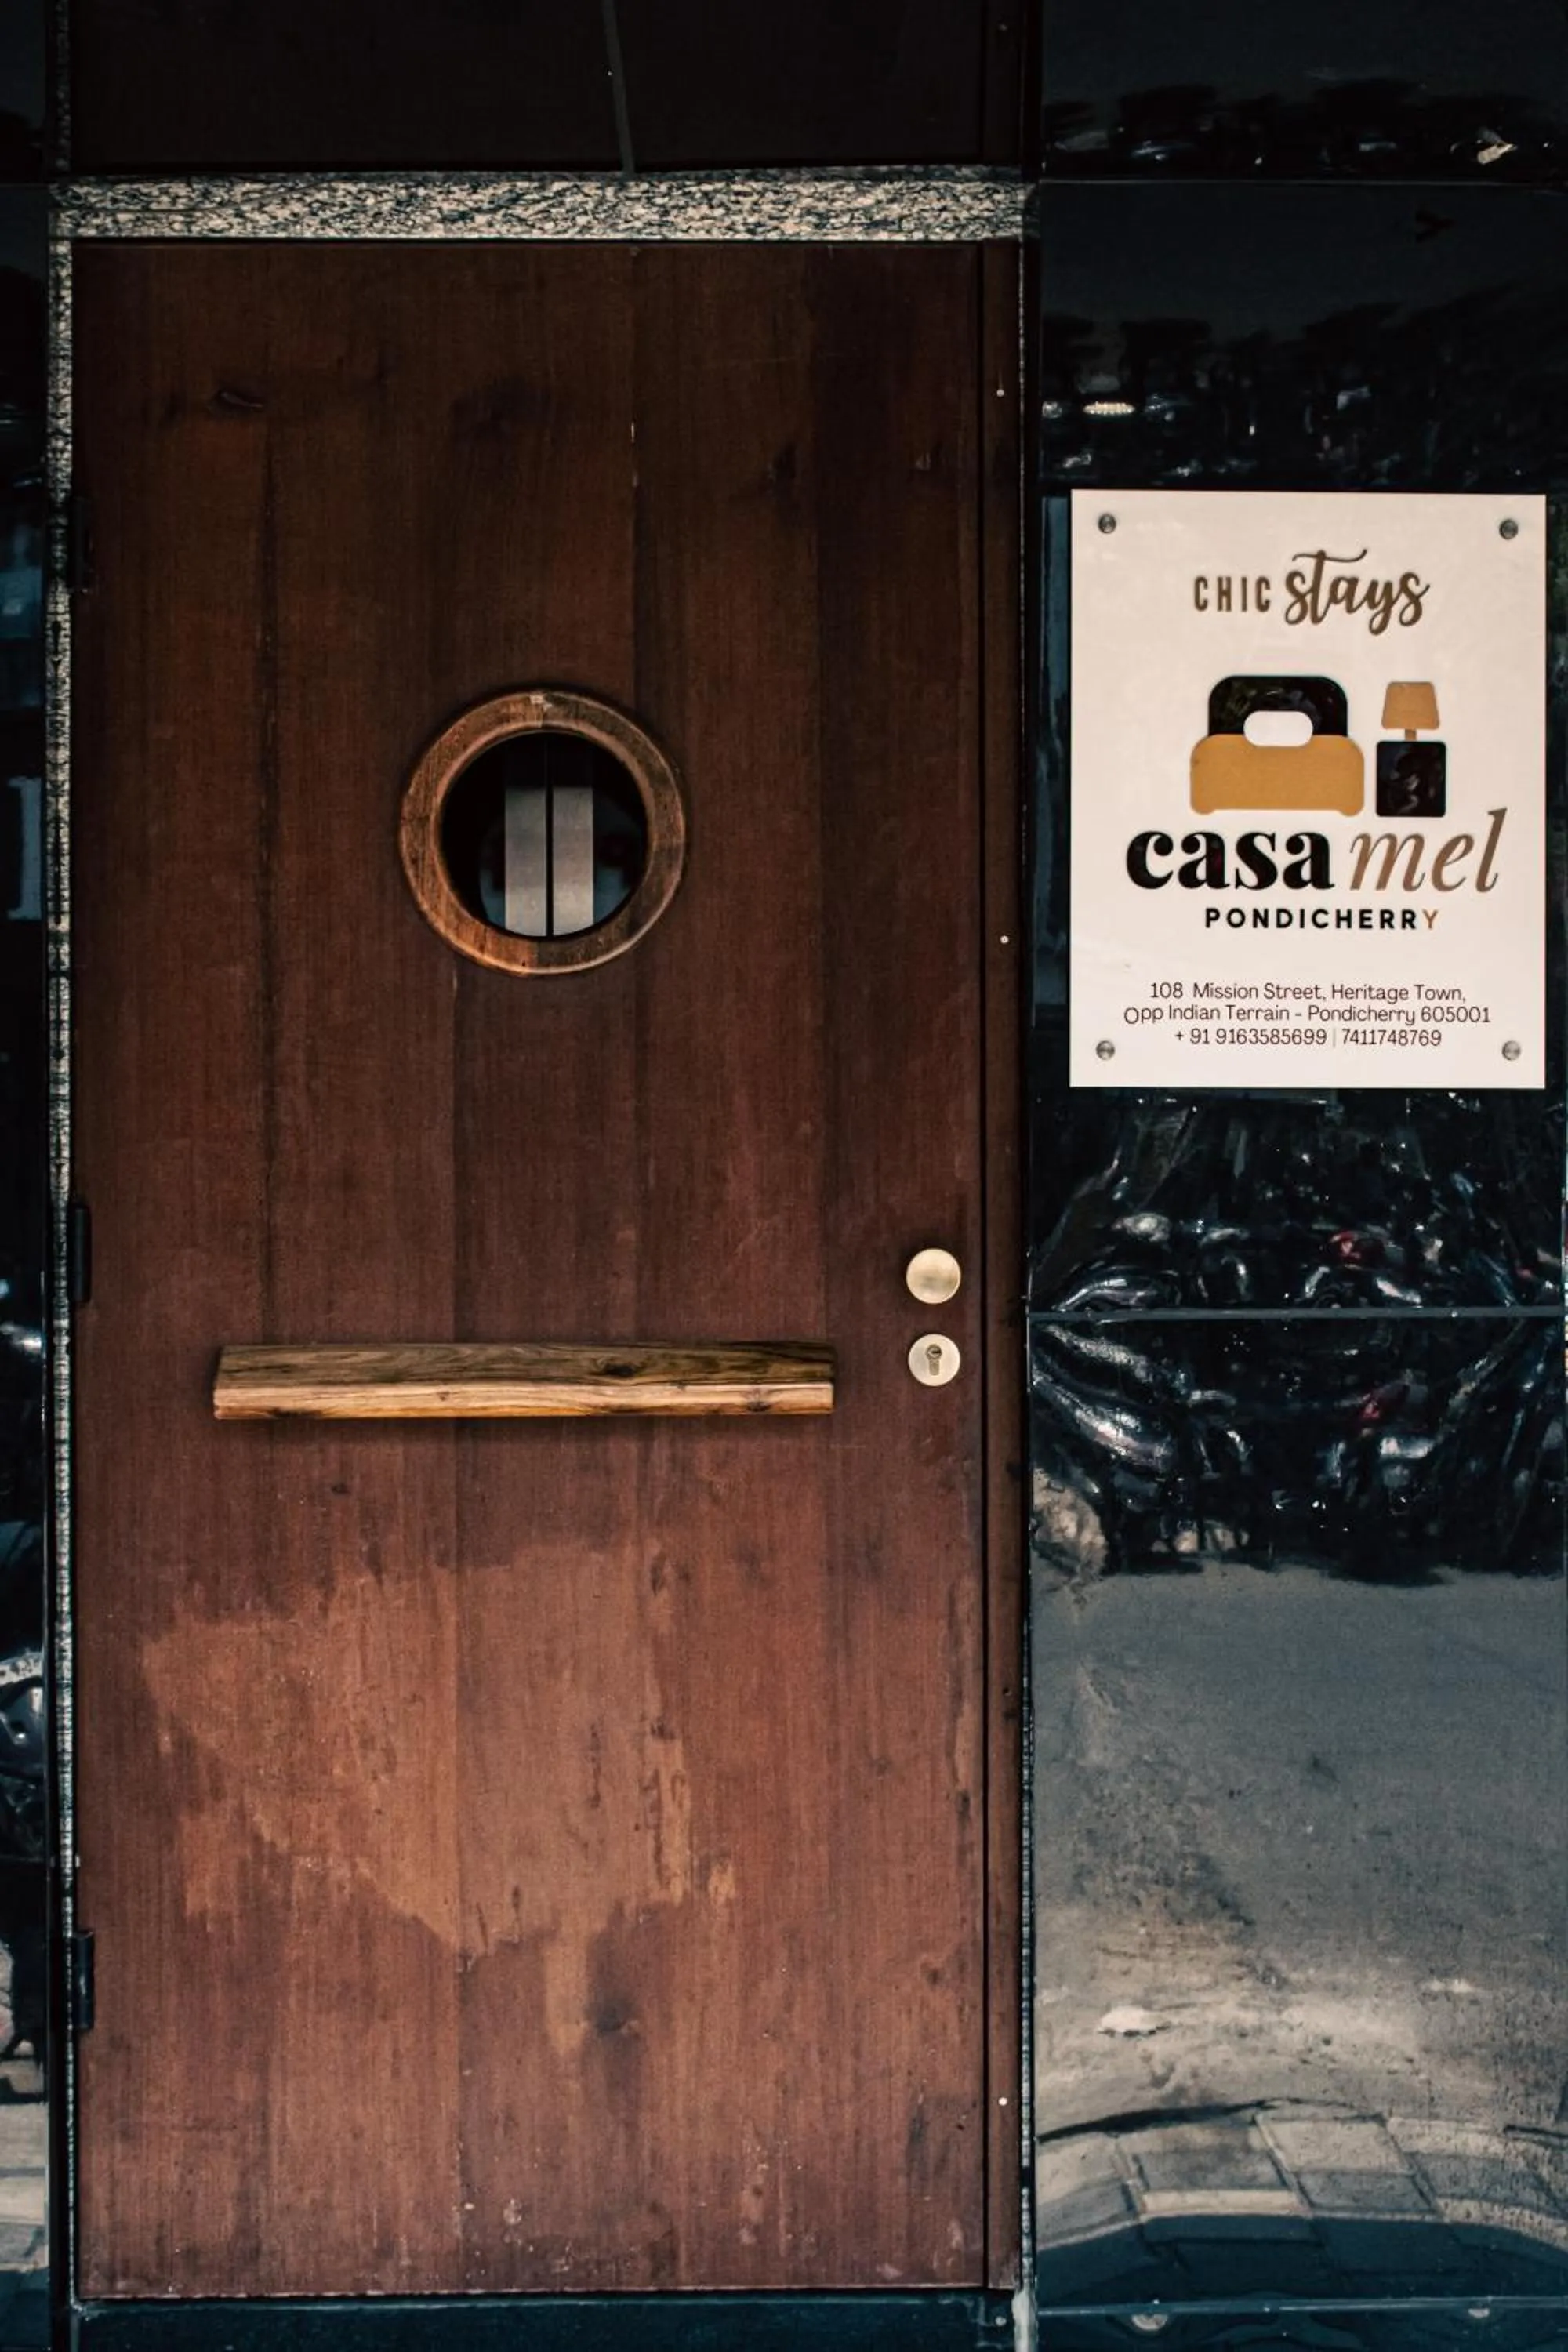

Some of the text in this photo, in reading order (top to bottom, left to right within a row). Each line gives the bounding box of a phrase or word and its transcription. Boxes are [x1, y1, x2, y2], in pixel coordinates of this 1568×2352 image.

[1193, 548, 1432, 637] CHIC stays
[1125, 807, 1508, 893] casa mel
[1204, 907, 1439, 931] PONDICHERRY
[1150, 982, 1466, 1005] 108 Mission Street, Heritage Town,
[1123, 1006, 1164, 1025] Opp
[1169, 1004, 1221, 1021] Indian
[1225, 1004, 1290, 1022] Terrain
[1308, 1004, 1416, 1026] Pondicherry
[1420, 1005, 1491, 1024] 605001
[1189, 1027, 1210, 1045] 91
[1215, 1028, 1327, 1045] 9163585699
[1341, 1028, 1442, 1047] 7411748769
